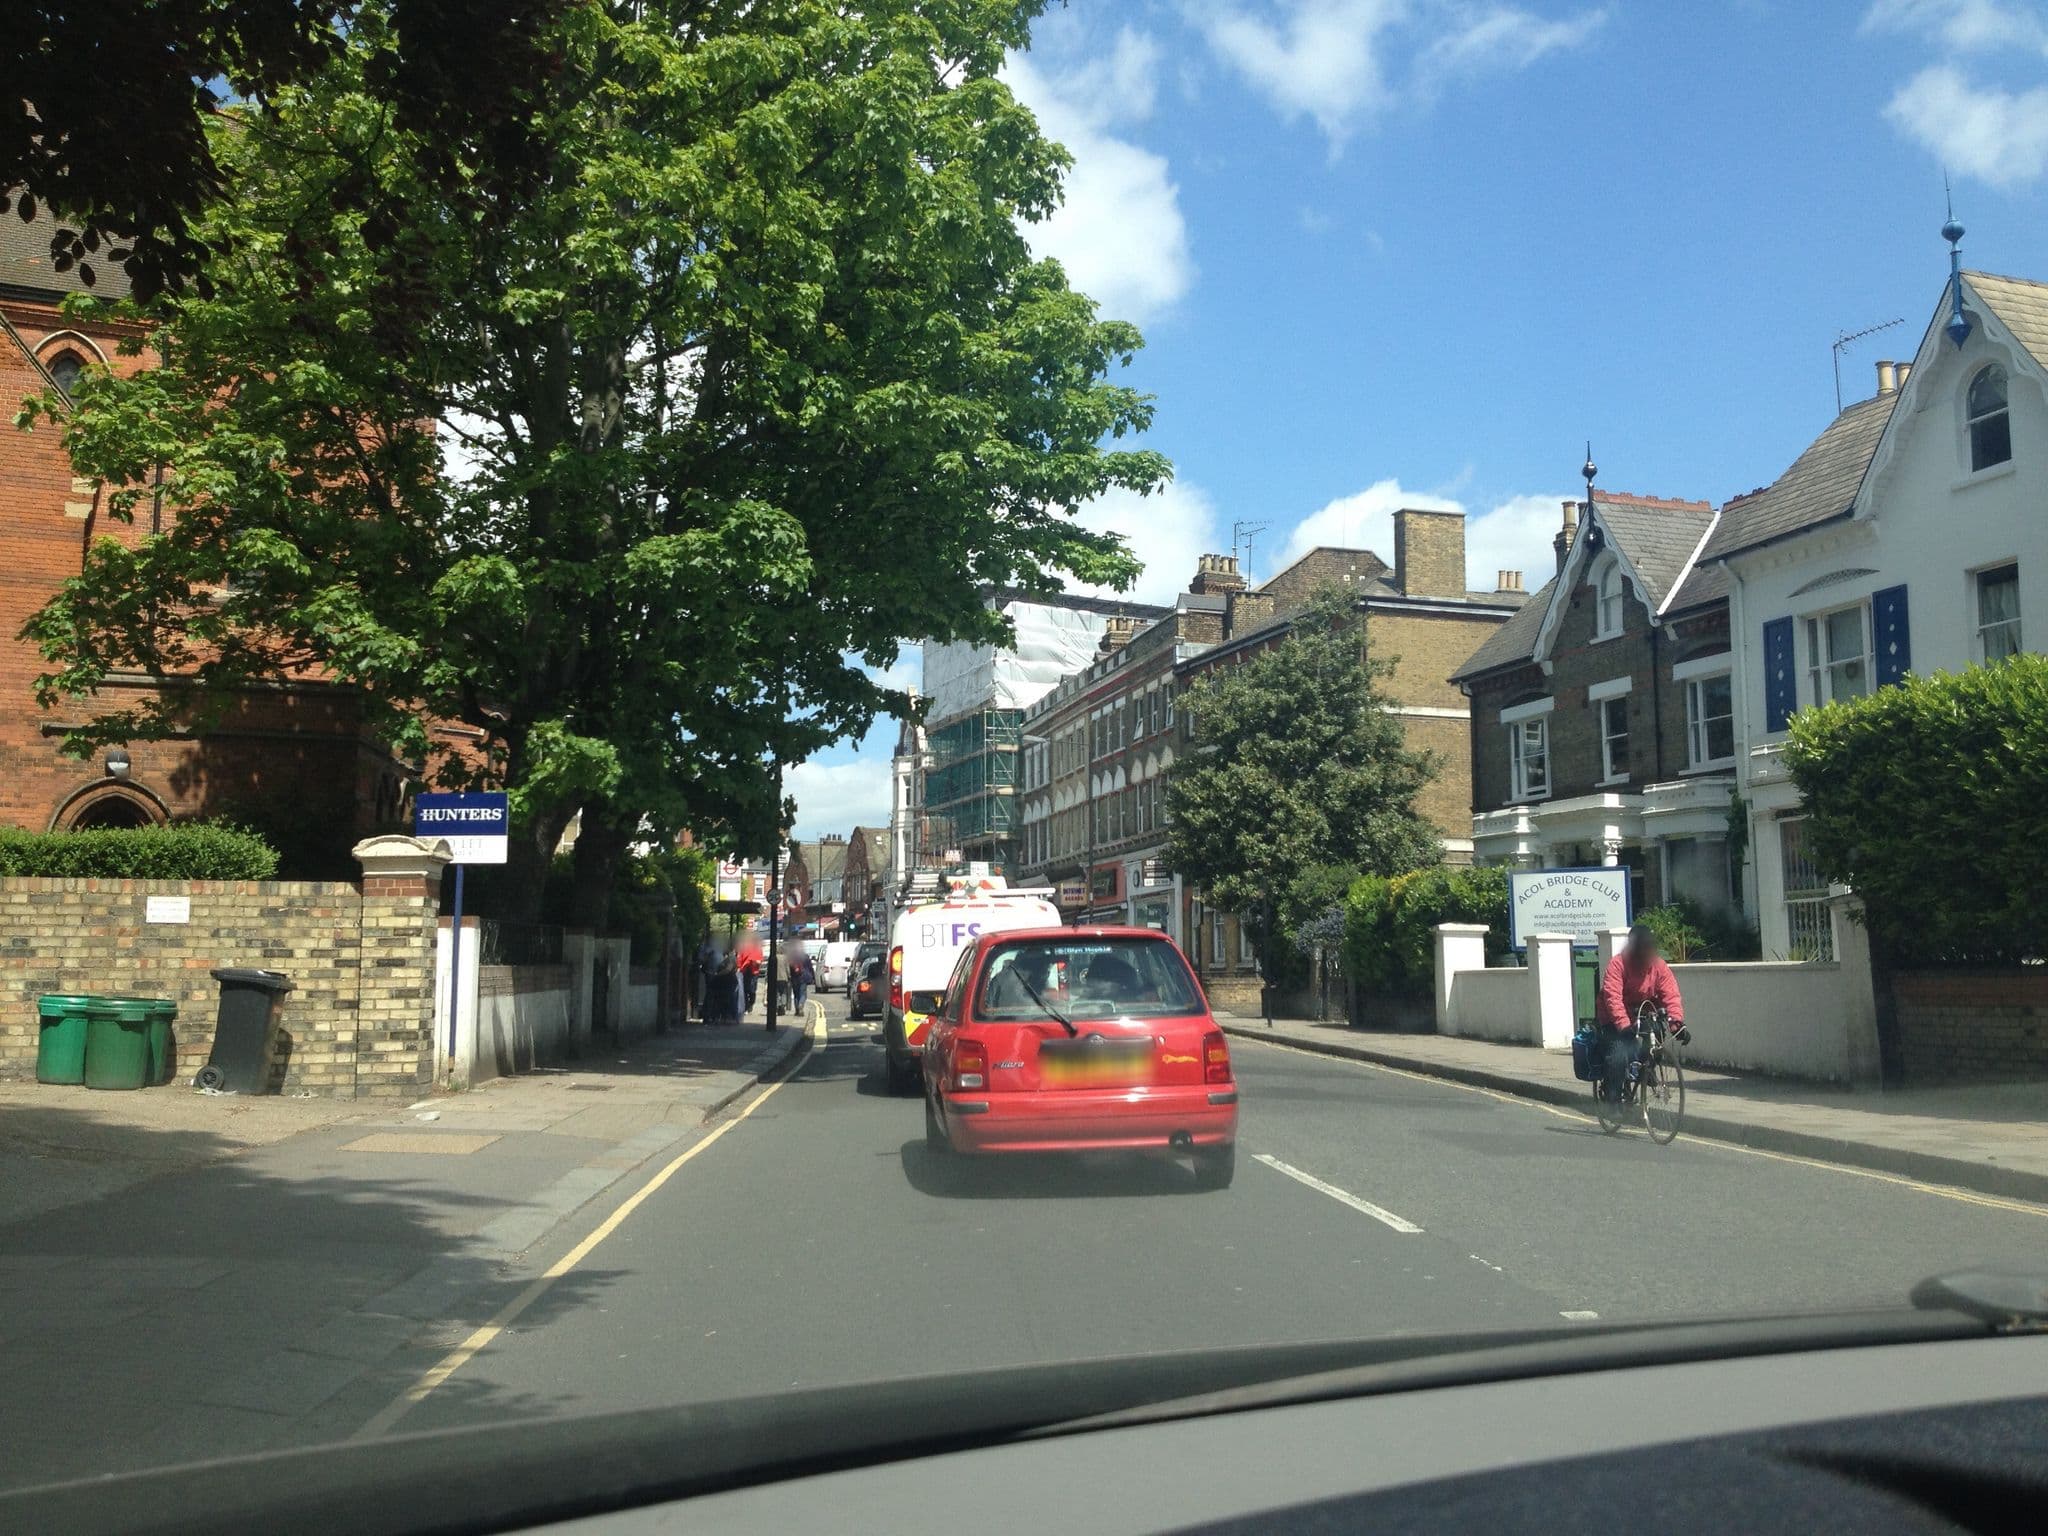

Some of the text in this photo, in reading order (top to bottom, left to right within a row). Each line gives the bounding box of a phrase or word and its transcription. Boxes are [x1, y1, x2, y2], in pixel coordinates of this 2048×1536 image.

[420, 808, 502, 821] HUNTERS
[1518, 875, 1621, 905] ACOL BRIDGE CLUB
[1564, 888, 1572, 897] &
[1543, 899, 1594, 909] ACADEMY
